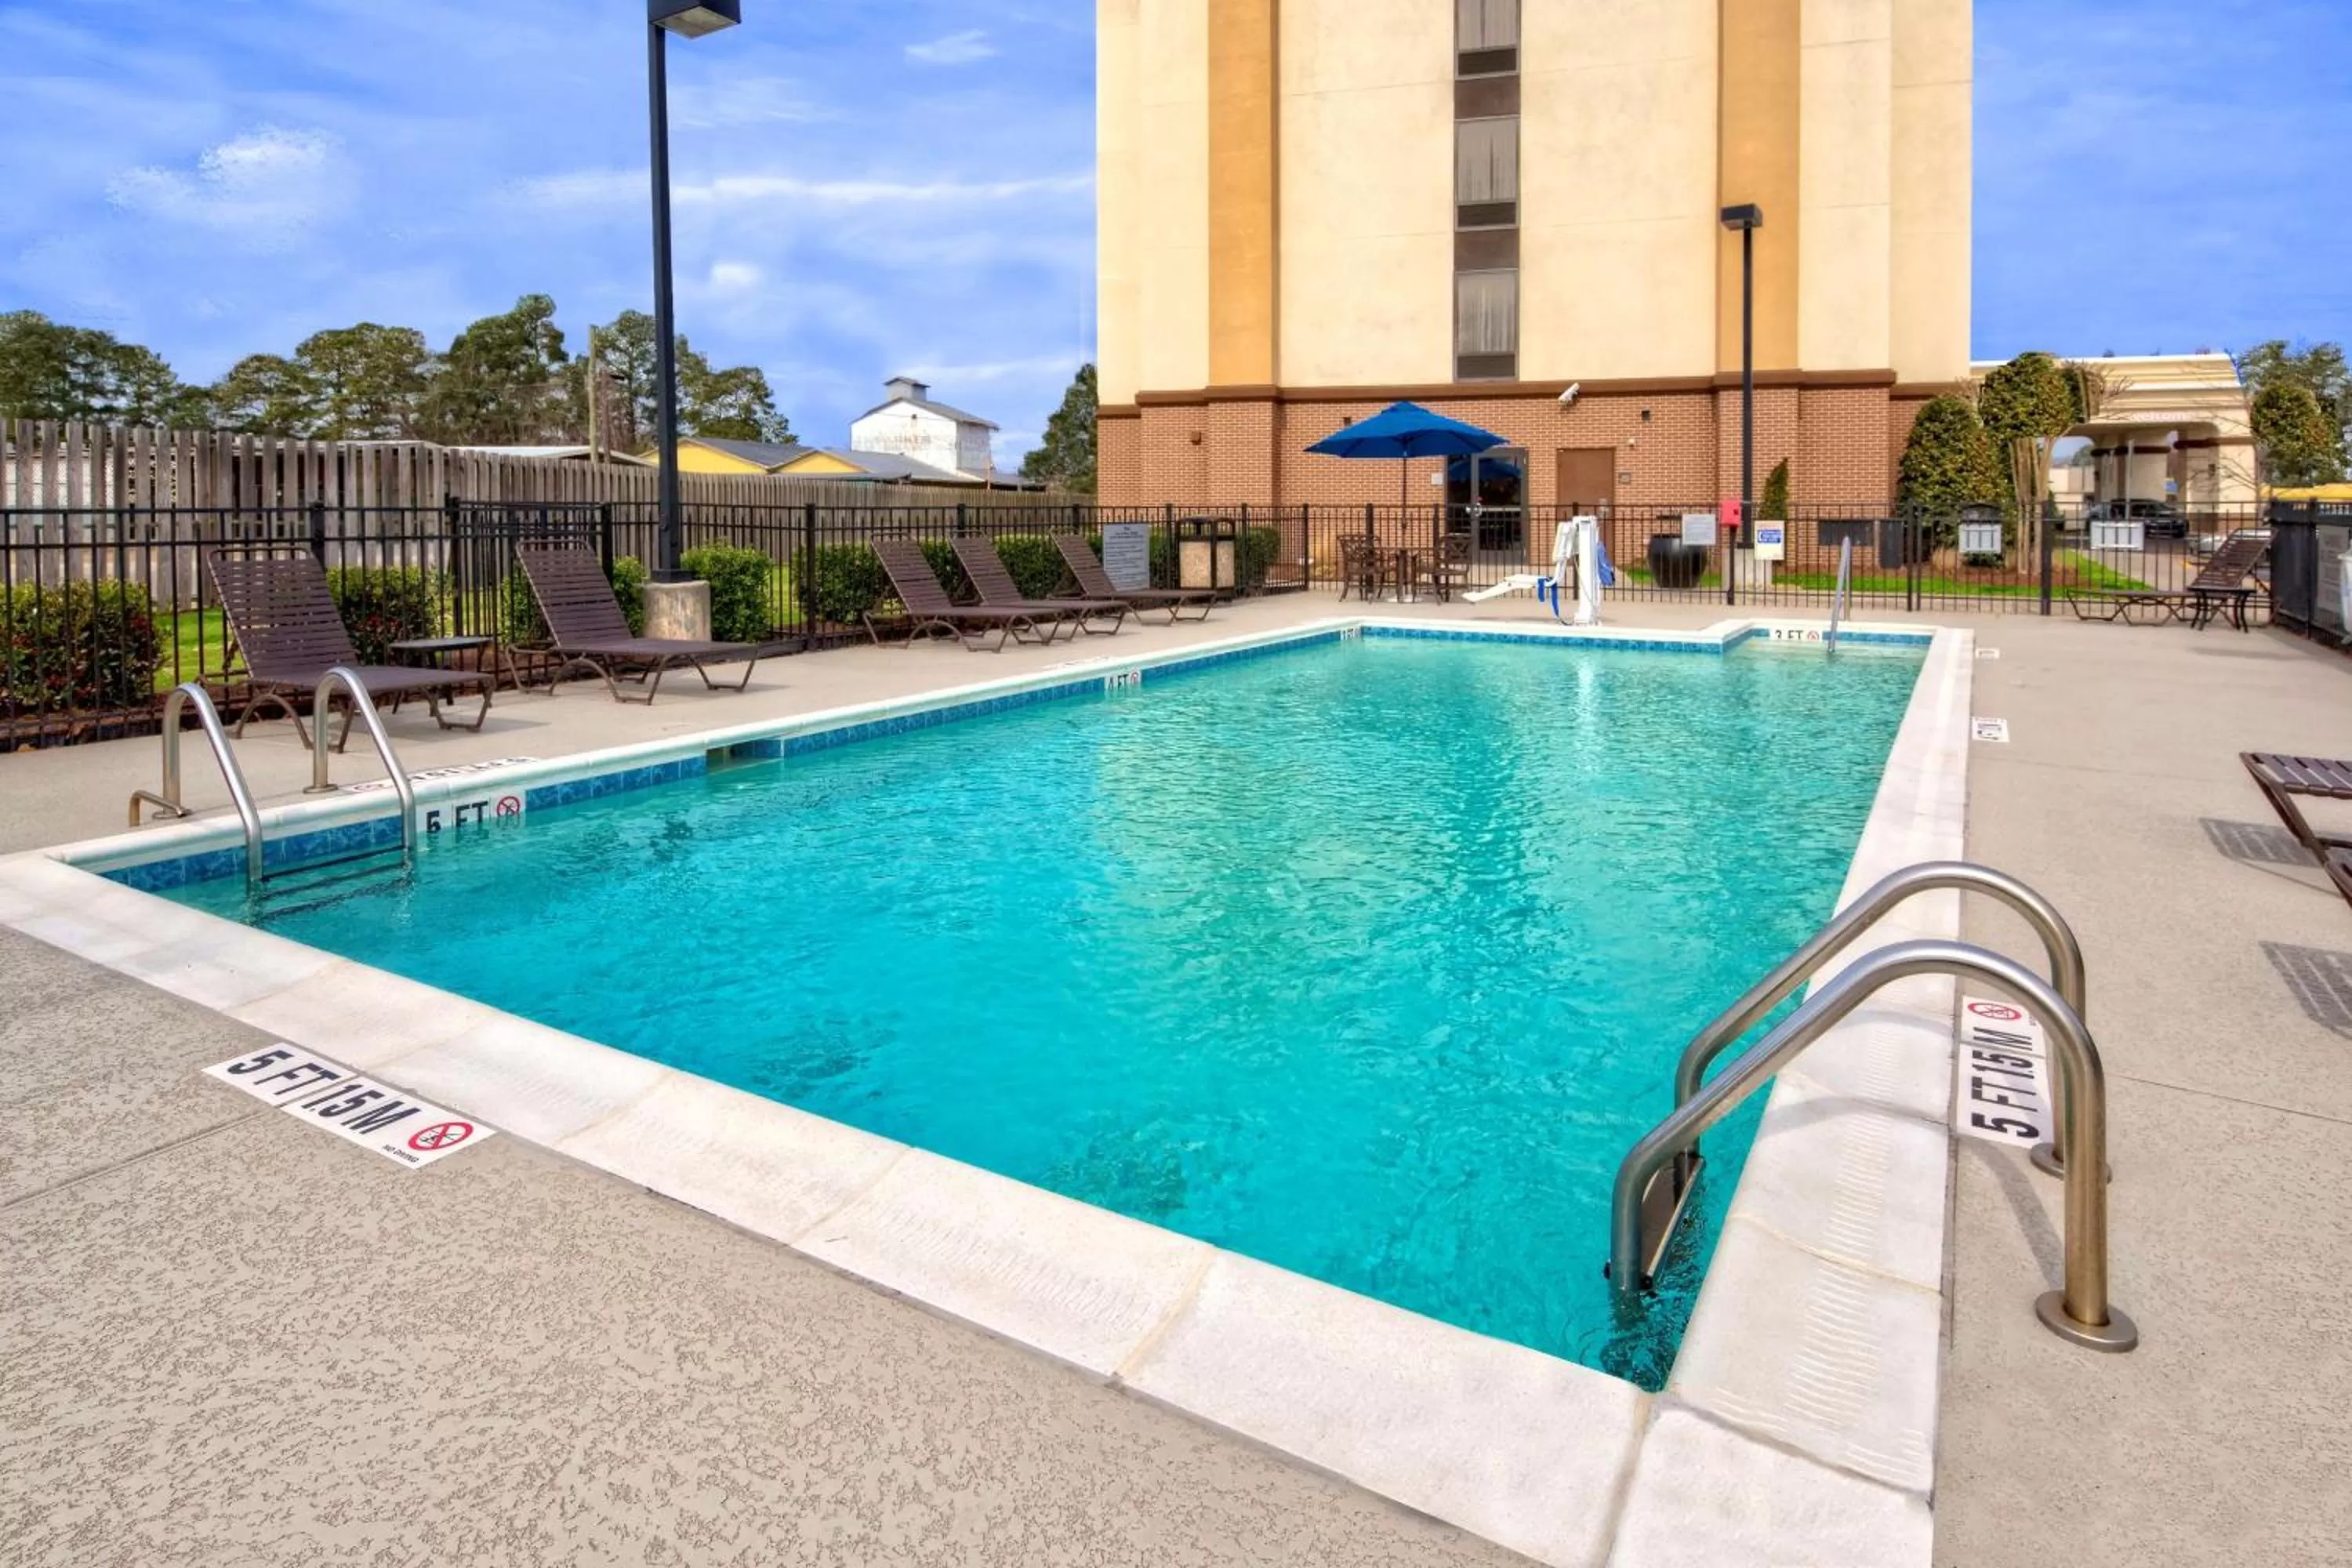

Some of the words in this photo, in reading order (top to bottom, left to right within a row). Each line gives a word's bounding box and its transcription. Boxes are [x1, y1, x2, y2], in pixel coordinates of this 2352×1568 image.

[426, 810, 441, 833] 5
[456, 800, 488, 827] FT
[227, 1050, 295, 1075] 5
[252, 1062, 341, 1095] FT
[1971, 1076, 2038, 1112] FT
[1971, 1112, 2040, 1139] 5
